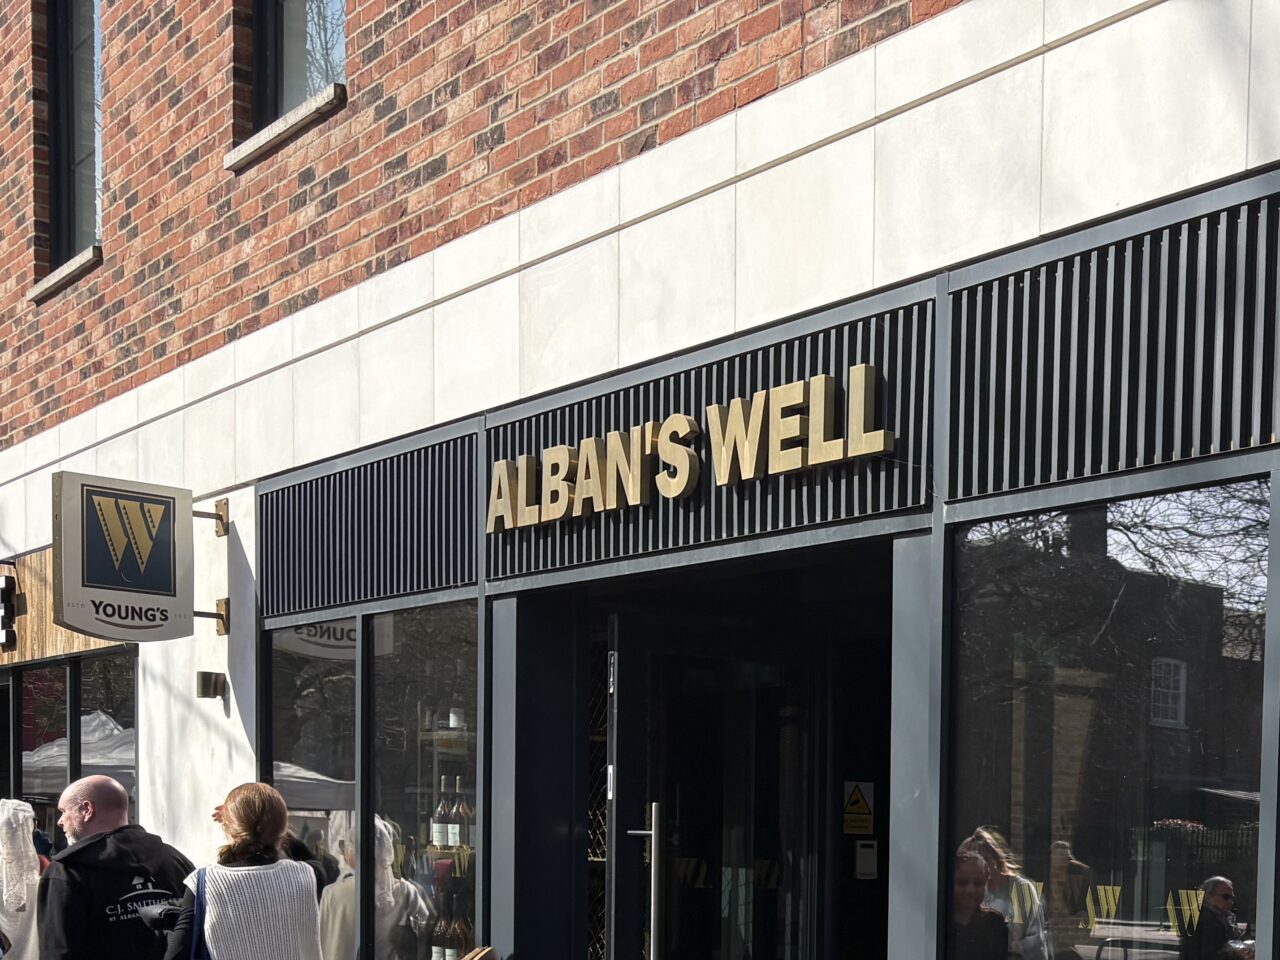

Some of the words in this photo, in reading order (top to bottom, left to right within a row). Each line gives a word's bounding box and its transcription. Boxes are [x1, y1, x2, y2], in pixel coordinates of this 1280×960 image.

[486, 413, 700, 534] ALBAN'S
[706, 363, 894, 487] WELL
[90, 599, 169, 622] YOUNG'S
